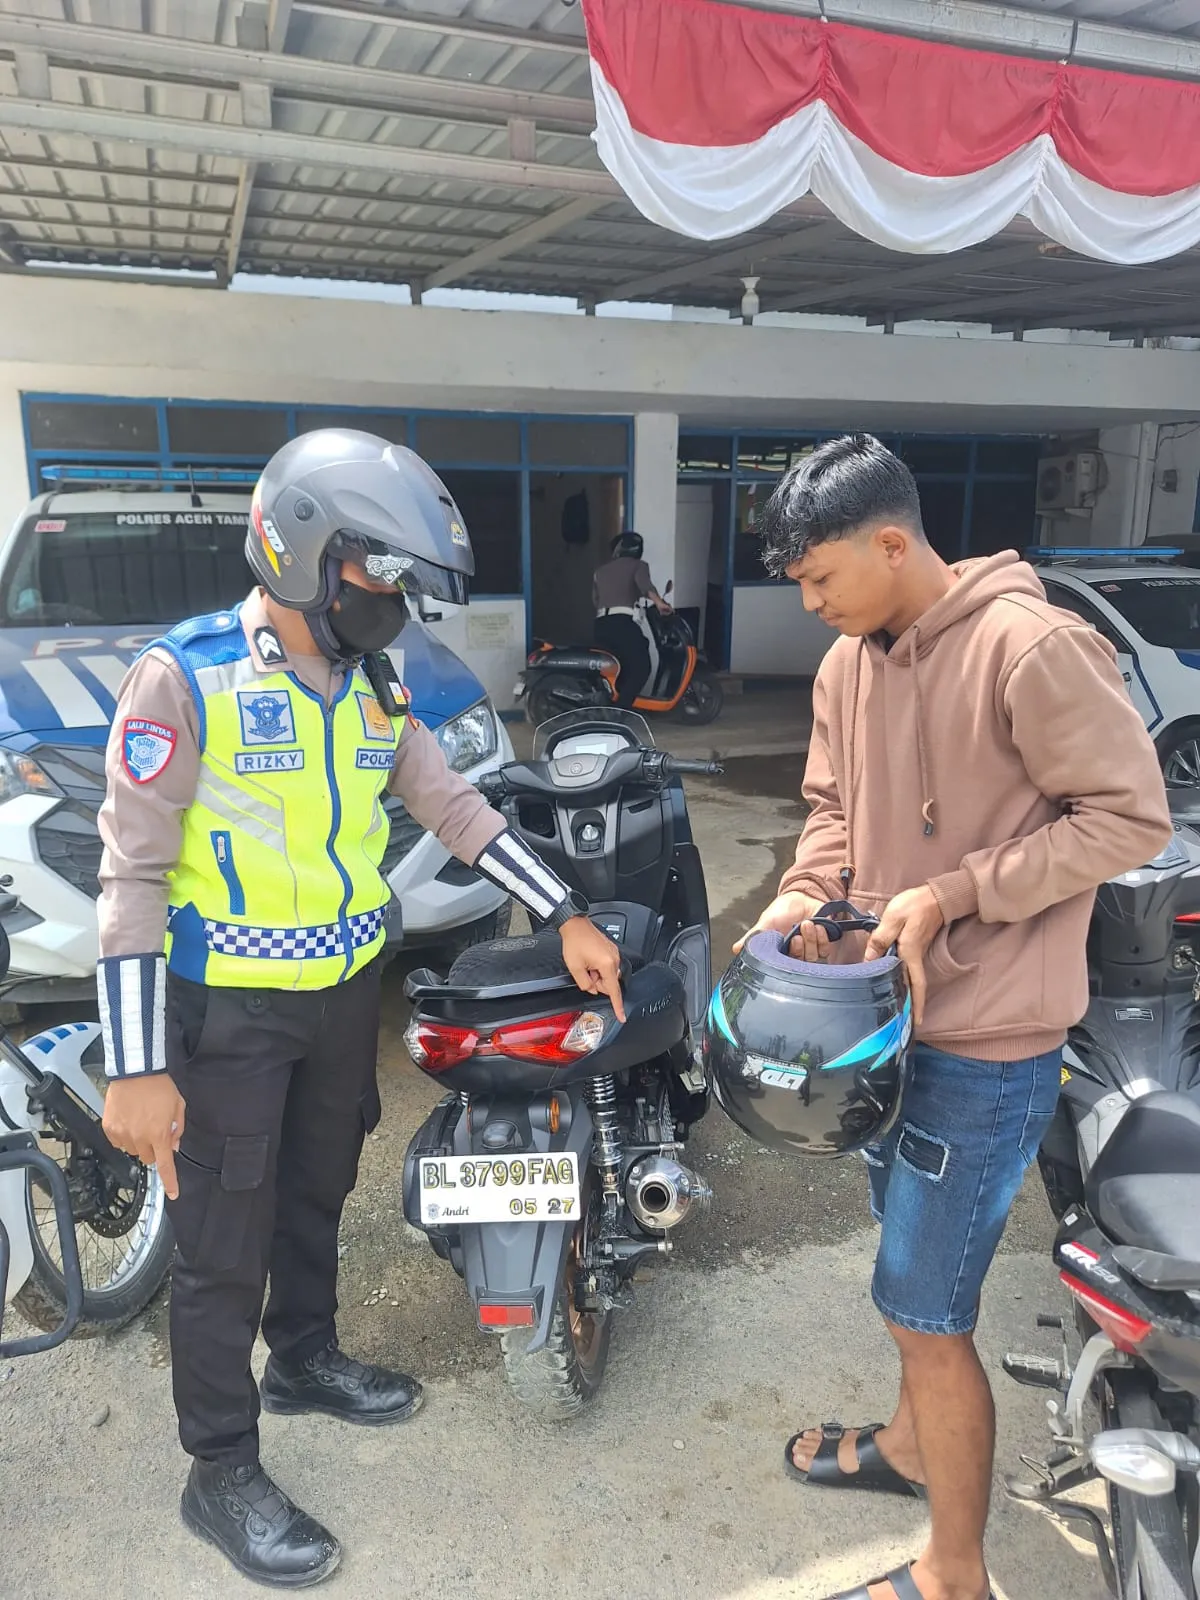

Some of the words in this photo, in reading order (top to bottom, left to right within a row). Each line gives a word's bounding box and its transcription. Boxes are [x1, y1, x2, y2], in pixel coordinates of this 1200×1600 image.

[117, 514, 171, 525] POLRES
[174, 514, 213, 525] ACEH
[127, 721, 145, 730] LALU
[145, 722, 172, 738] LINTAS
[244, 753, 298, 770] RIZKY
[422, 1162, 456, 1189] BL
[442, 1205, 470, 1217] Andri
[509, 1198, 537, 1215] 05
[547, 1197, 575, 1215] 27
